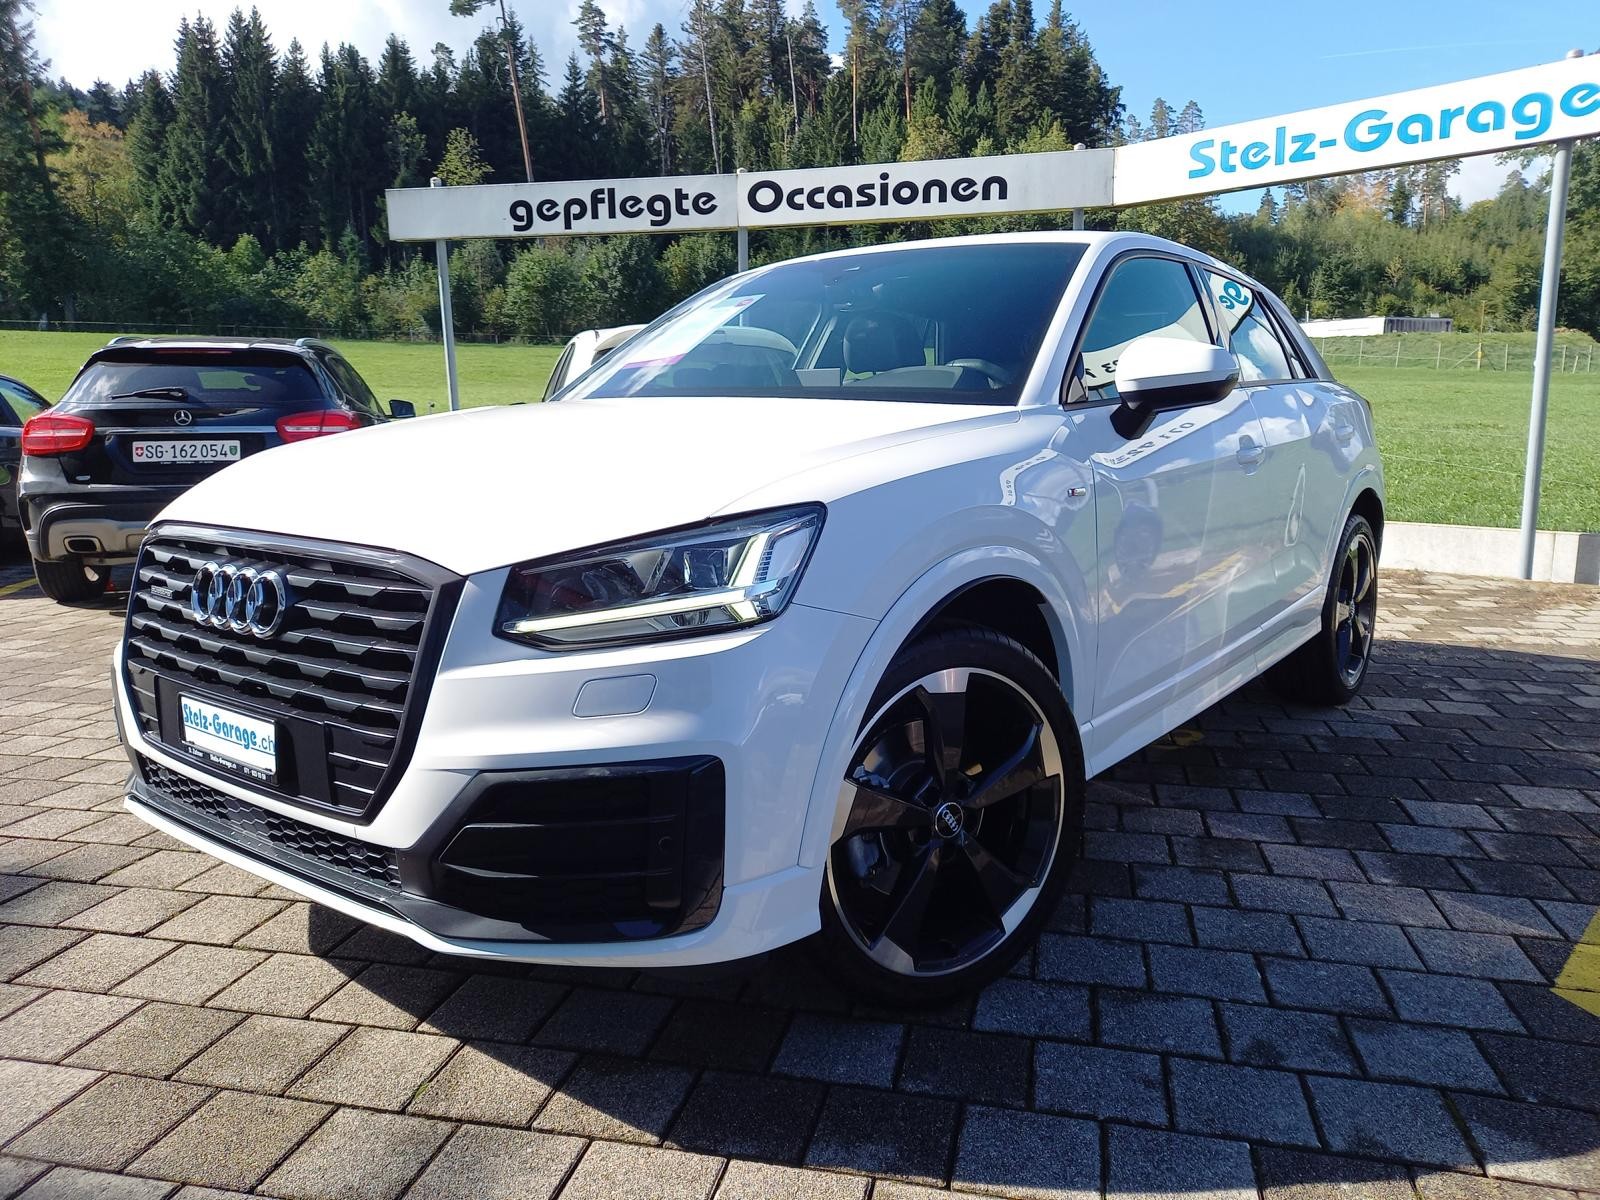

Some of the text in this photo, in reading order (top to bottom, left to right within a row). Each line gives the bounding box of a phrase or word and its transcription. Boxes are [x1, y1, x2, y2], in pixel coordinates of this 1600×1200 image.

[1188, 83, 1600, 179] Stelz-Garage
[509, 173, 1008, 231] gepflegte Occasionen
